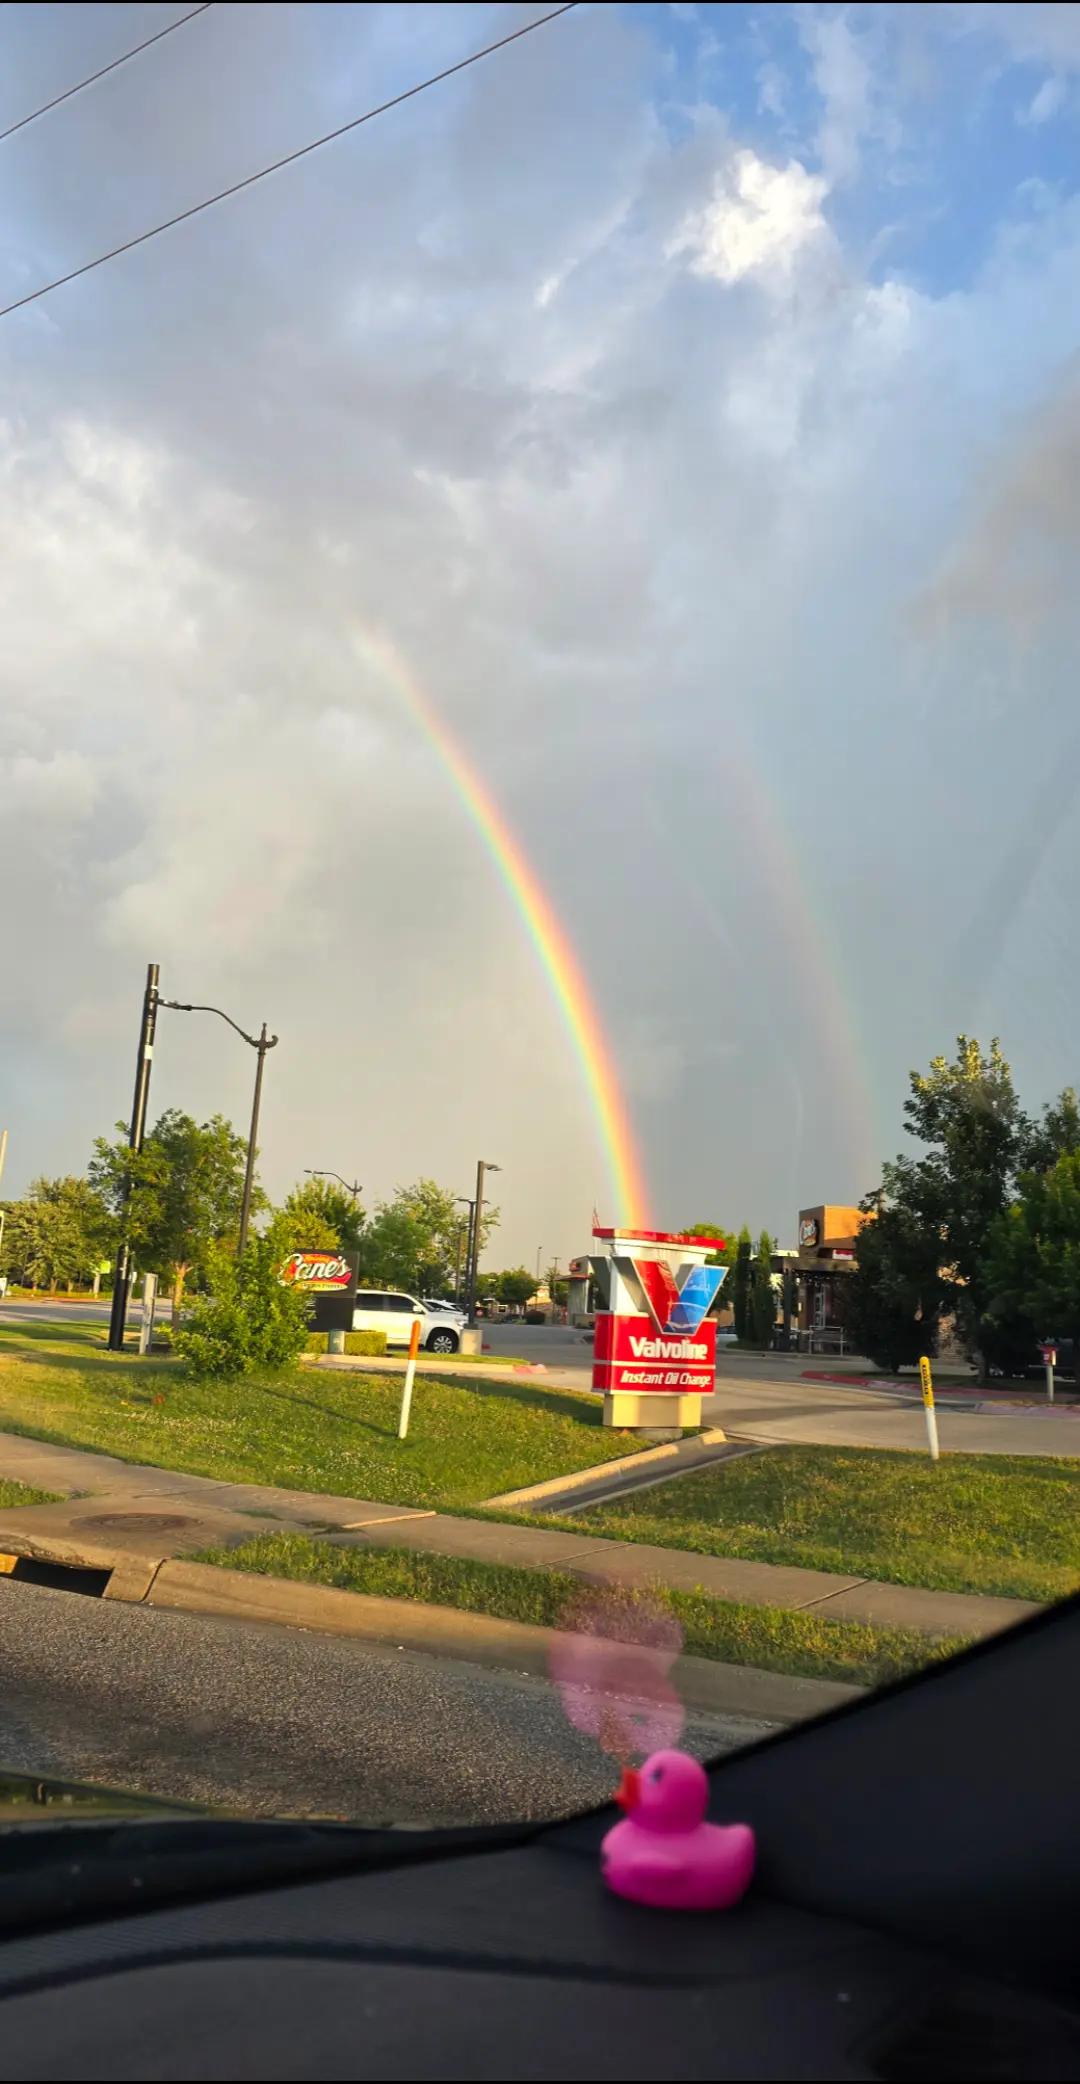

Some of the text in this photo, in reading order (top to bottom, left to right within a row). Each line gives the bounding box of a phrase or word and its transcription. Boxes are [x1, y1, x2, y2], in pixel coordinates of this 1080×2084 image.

[277, 1253, 352, 1287] Cane's
[629, 1336, 708, 1360] Valvoline
[620, 1370, 663, 1385] Instant
[664, 1371, 679, 1385] Oil
